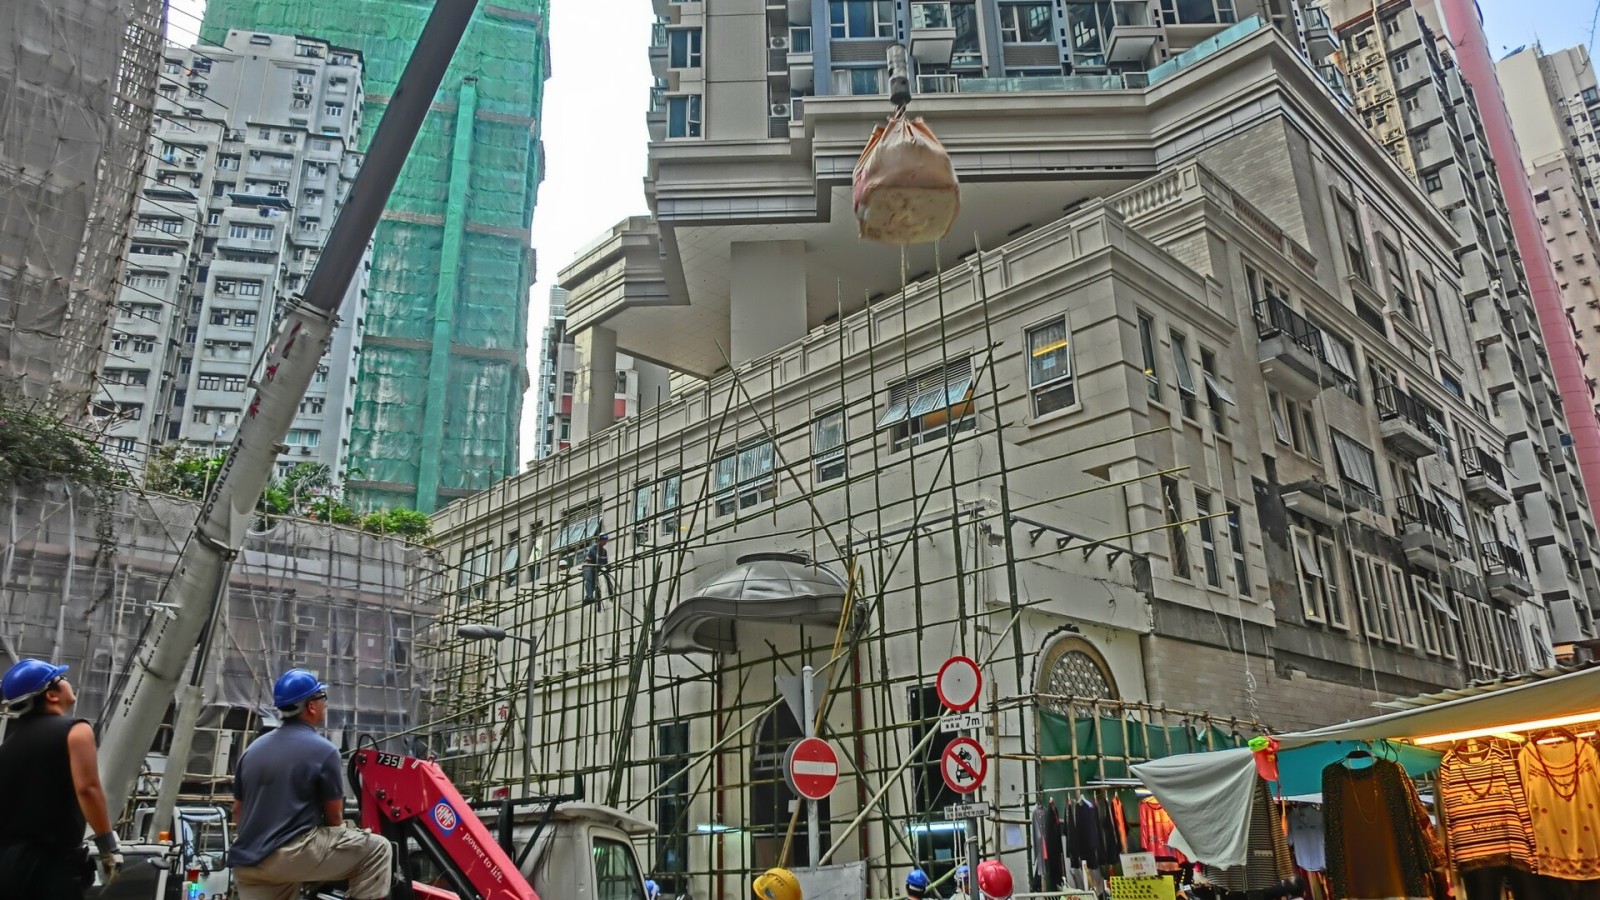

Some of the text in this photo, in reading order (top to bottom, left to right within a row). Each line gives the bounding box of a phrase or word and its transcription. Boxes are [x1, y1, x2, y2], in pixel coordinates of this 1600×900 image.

[202, 446, 240, 525] ZOOMLION
[123, 707, 130, 717] NO
[128, 674, 145, 706] STANDING
[964, 715, 980, 727] 7m
[377, 753, 399, 767] 735
[435, 804, 454, 828] HMF
[462, 832, 485, 858] power
[483, 857, 492, 868] to
[490, 865, 503, 884] lift.
